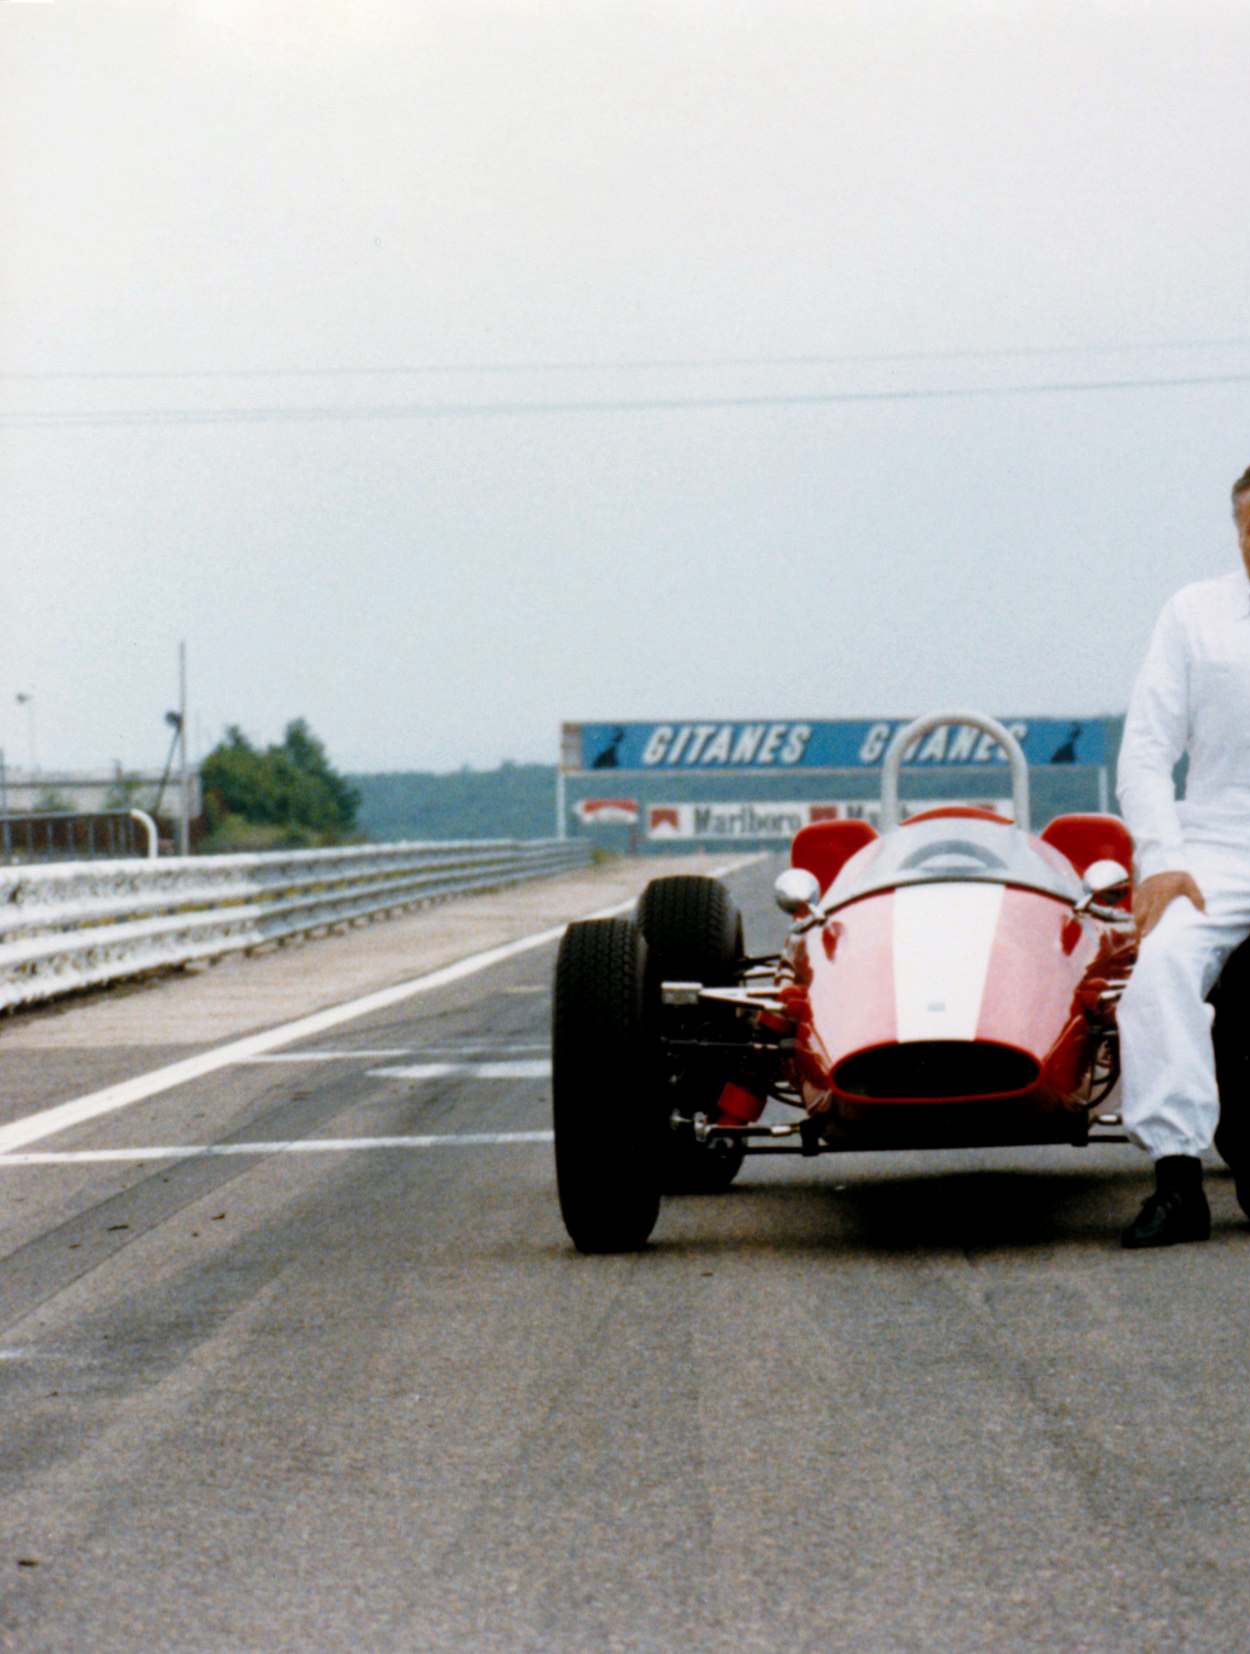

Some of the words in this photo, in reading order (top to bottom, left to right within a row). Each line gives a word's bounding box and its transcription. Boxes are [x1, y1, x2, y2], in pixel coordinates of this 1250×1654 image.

[642, 724, 811, 764] GITANES
[859, 723, 1028, 762] GANE
[694, 806, 800, 833] Marlboro
